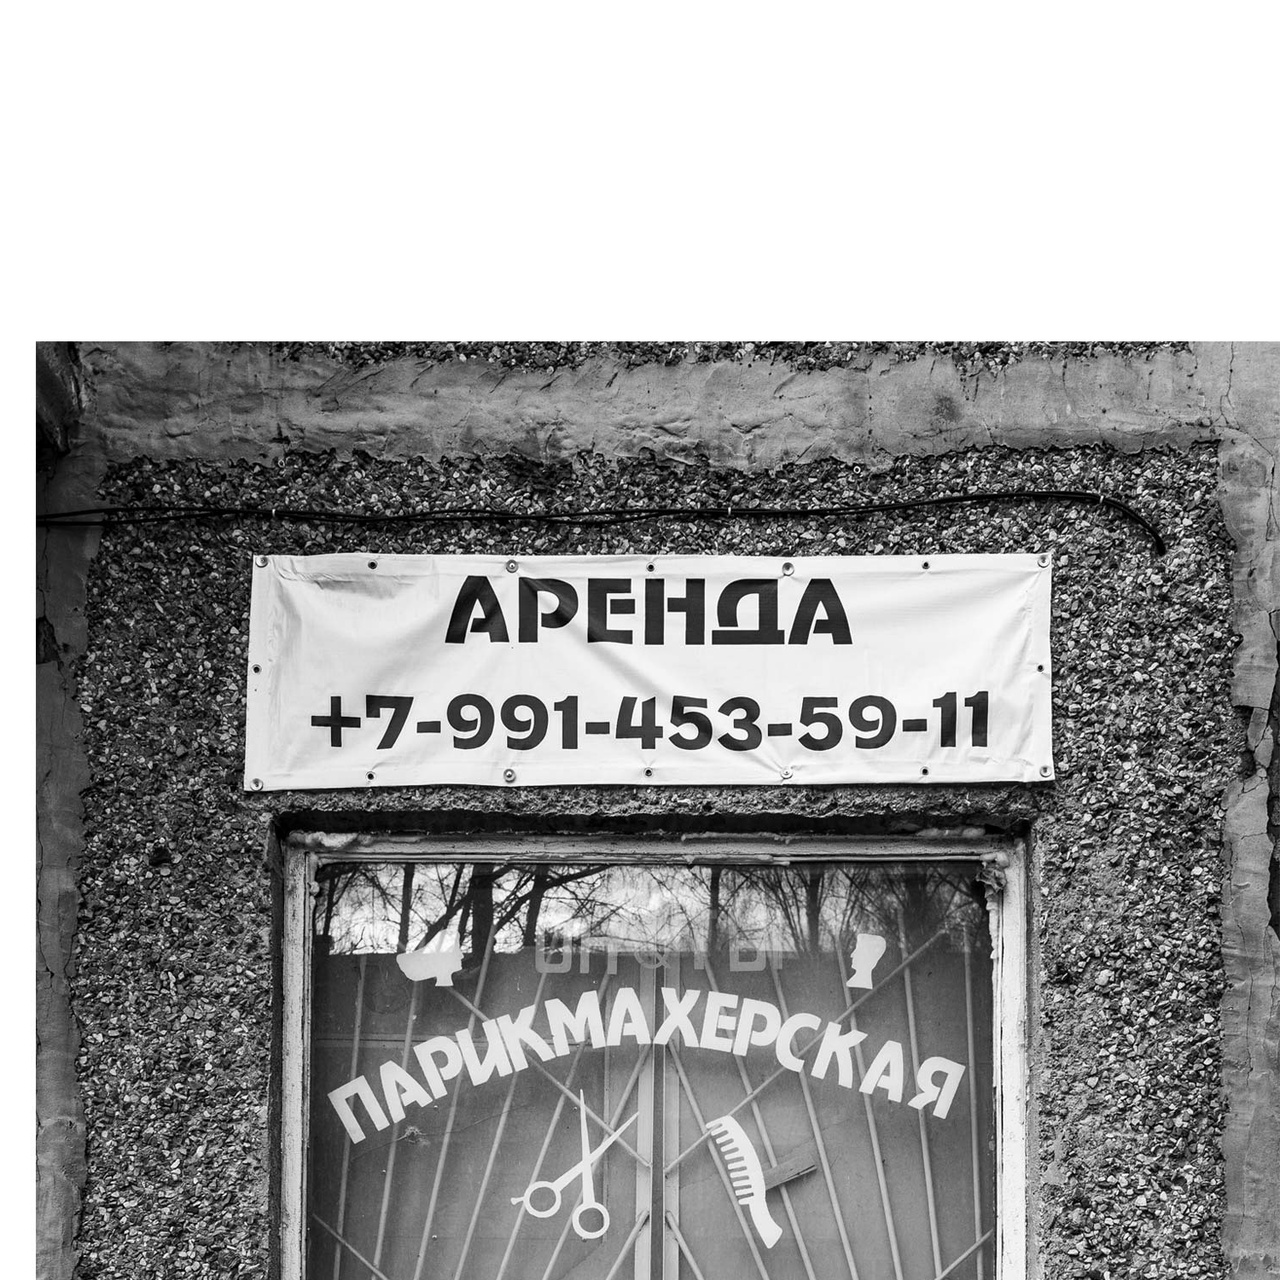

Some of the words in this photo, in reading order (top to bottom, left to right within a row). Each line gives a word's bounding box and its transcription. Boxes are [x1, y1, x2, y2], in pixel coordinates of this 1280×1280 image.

[444, 575, 853, 646] АРЕНДА
[311, 691, 989, 751] +7-991-453-59-11
[327, 987, 966, 1144] ПАРИКМАХЕРСКАЯ
